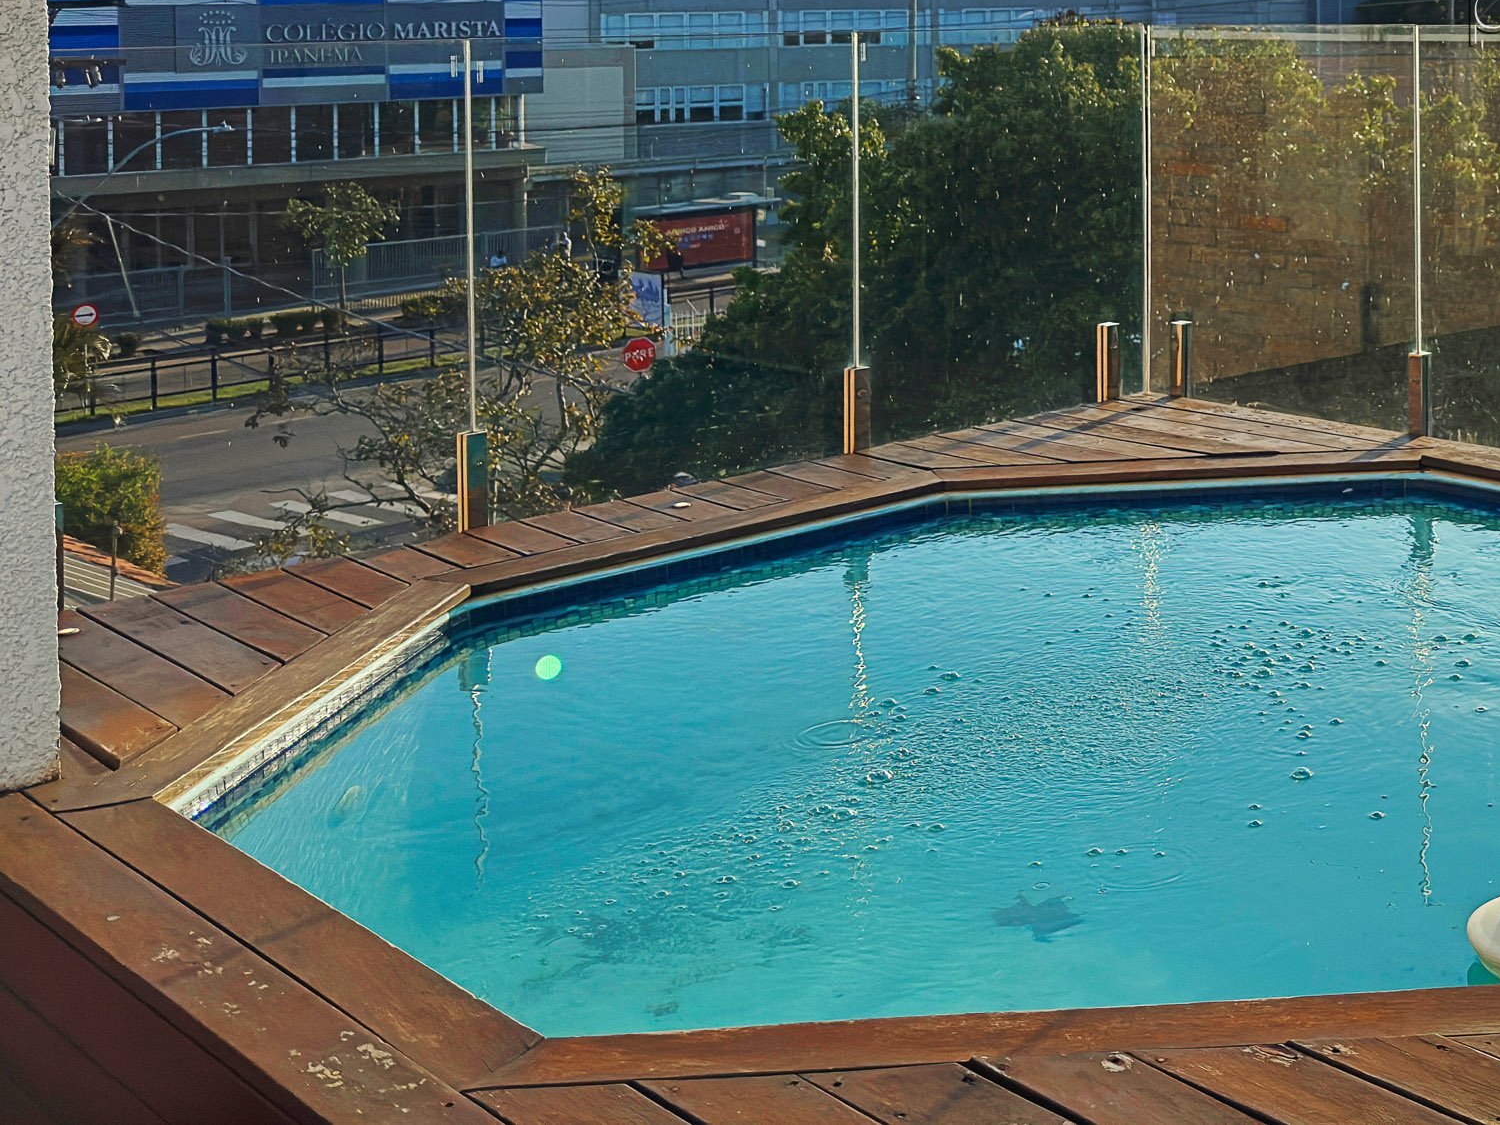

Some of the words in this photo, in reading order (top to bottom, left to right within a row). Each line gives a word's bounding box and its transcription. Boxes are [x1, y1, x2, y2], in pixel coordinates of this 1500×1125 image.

[266, 18, 385, 43] COLÉGIO
[394, 20, 501, 39] MARISTA
[270, 45, 363, 63] IPANEMA
